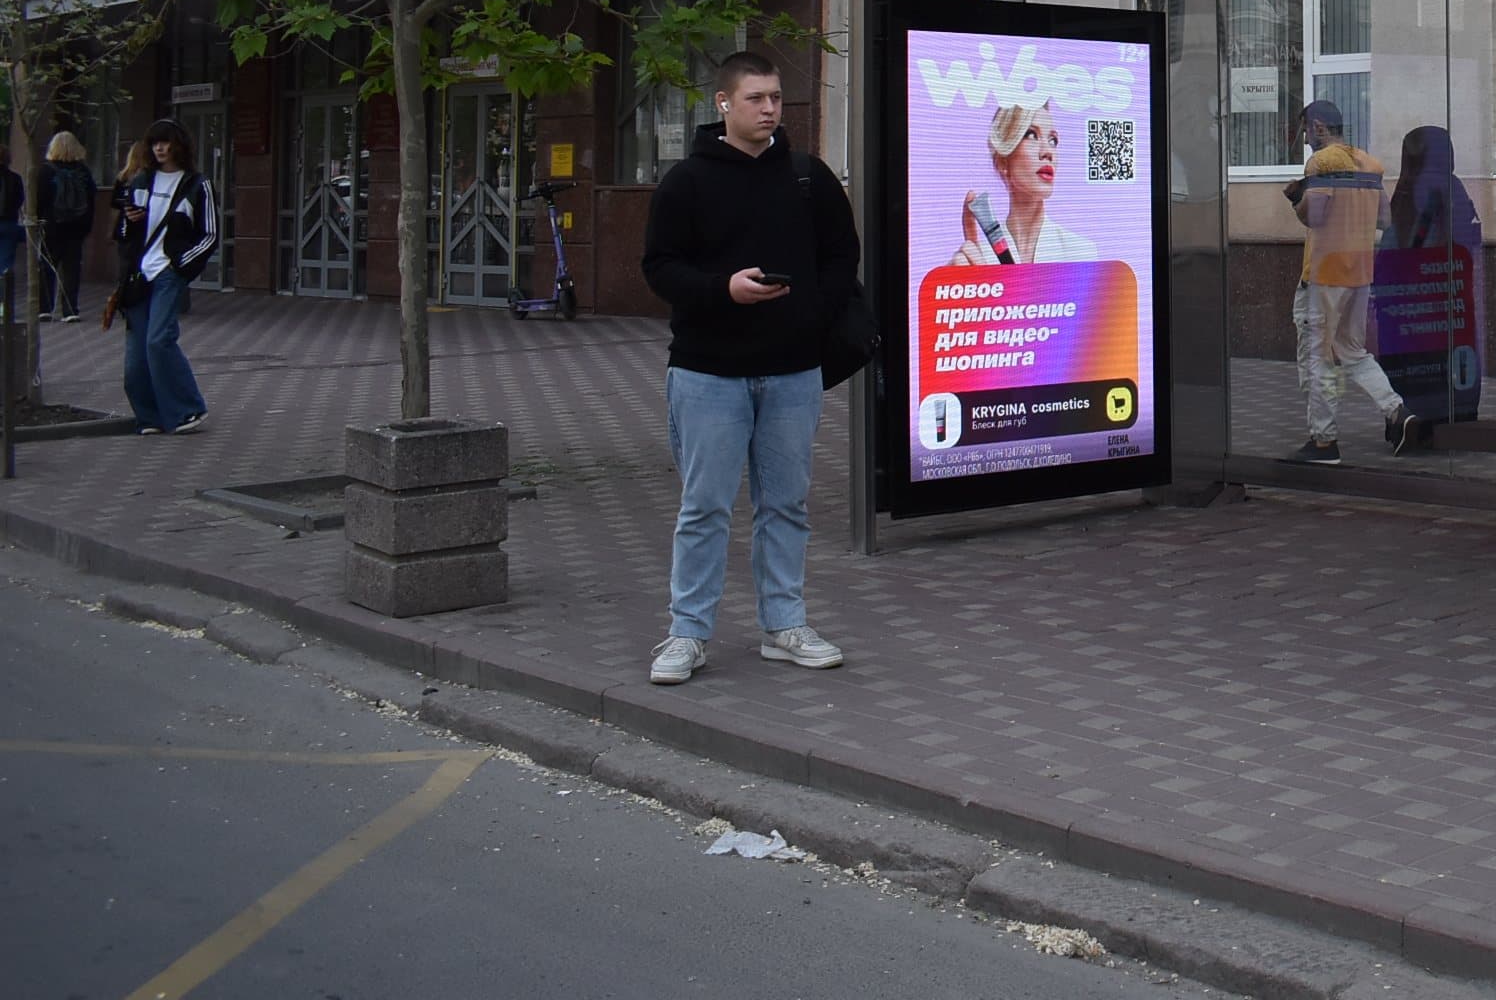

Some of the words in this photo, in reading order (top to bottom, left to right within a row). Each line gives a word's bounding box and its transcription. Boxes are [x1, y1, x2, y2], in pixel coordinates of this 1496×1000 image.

[1119, 45, 1146, 62] 12+
[917, 41, 1136, 113] wibes
[1241, 85, 1275, 93] УКРЫТИЕ
[934, 282, 1004, 301] новое
[934, 302, 1077, 329] приложение
[934, 330, 978, 352] для
[983, 326, 1060, 347] видео-
[935, 350, 1036, 373] шопинга
[971, 403, 1026, 420] KRYGINA
[1031, 397, 1091, 414] cosmetics
[972, 419, 996, 430] Блеск
[997, 419, 1012, 429] для
[1013, 417, 1027, 429] губ
[1108, 434, 1129, 446] ЕЛЕНА
[1108, 445, 1140, 457] КРЫГИНА
[922, 464, 966, 481] МОСКОВСКАЯ
